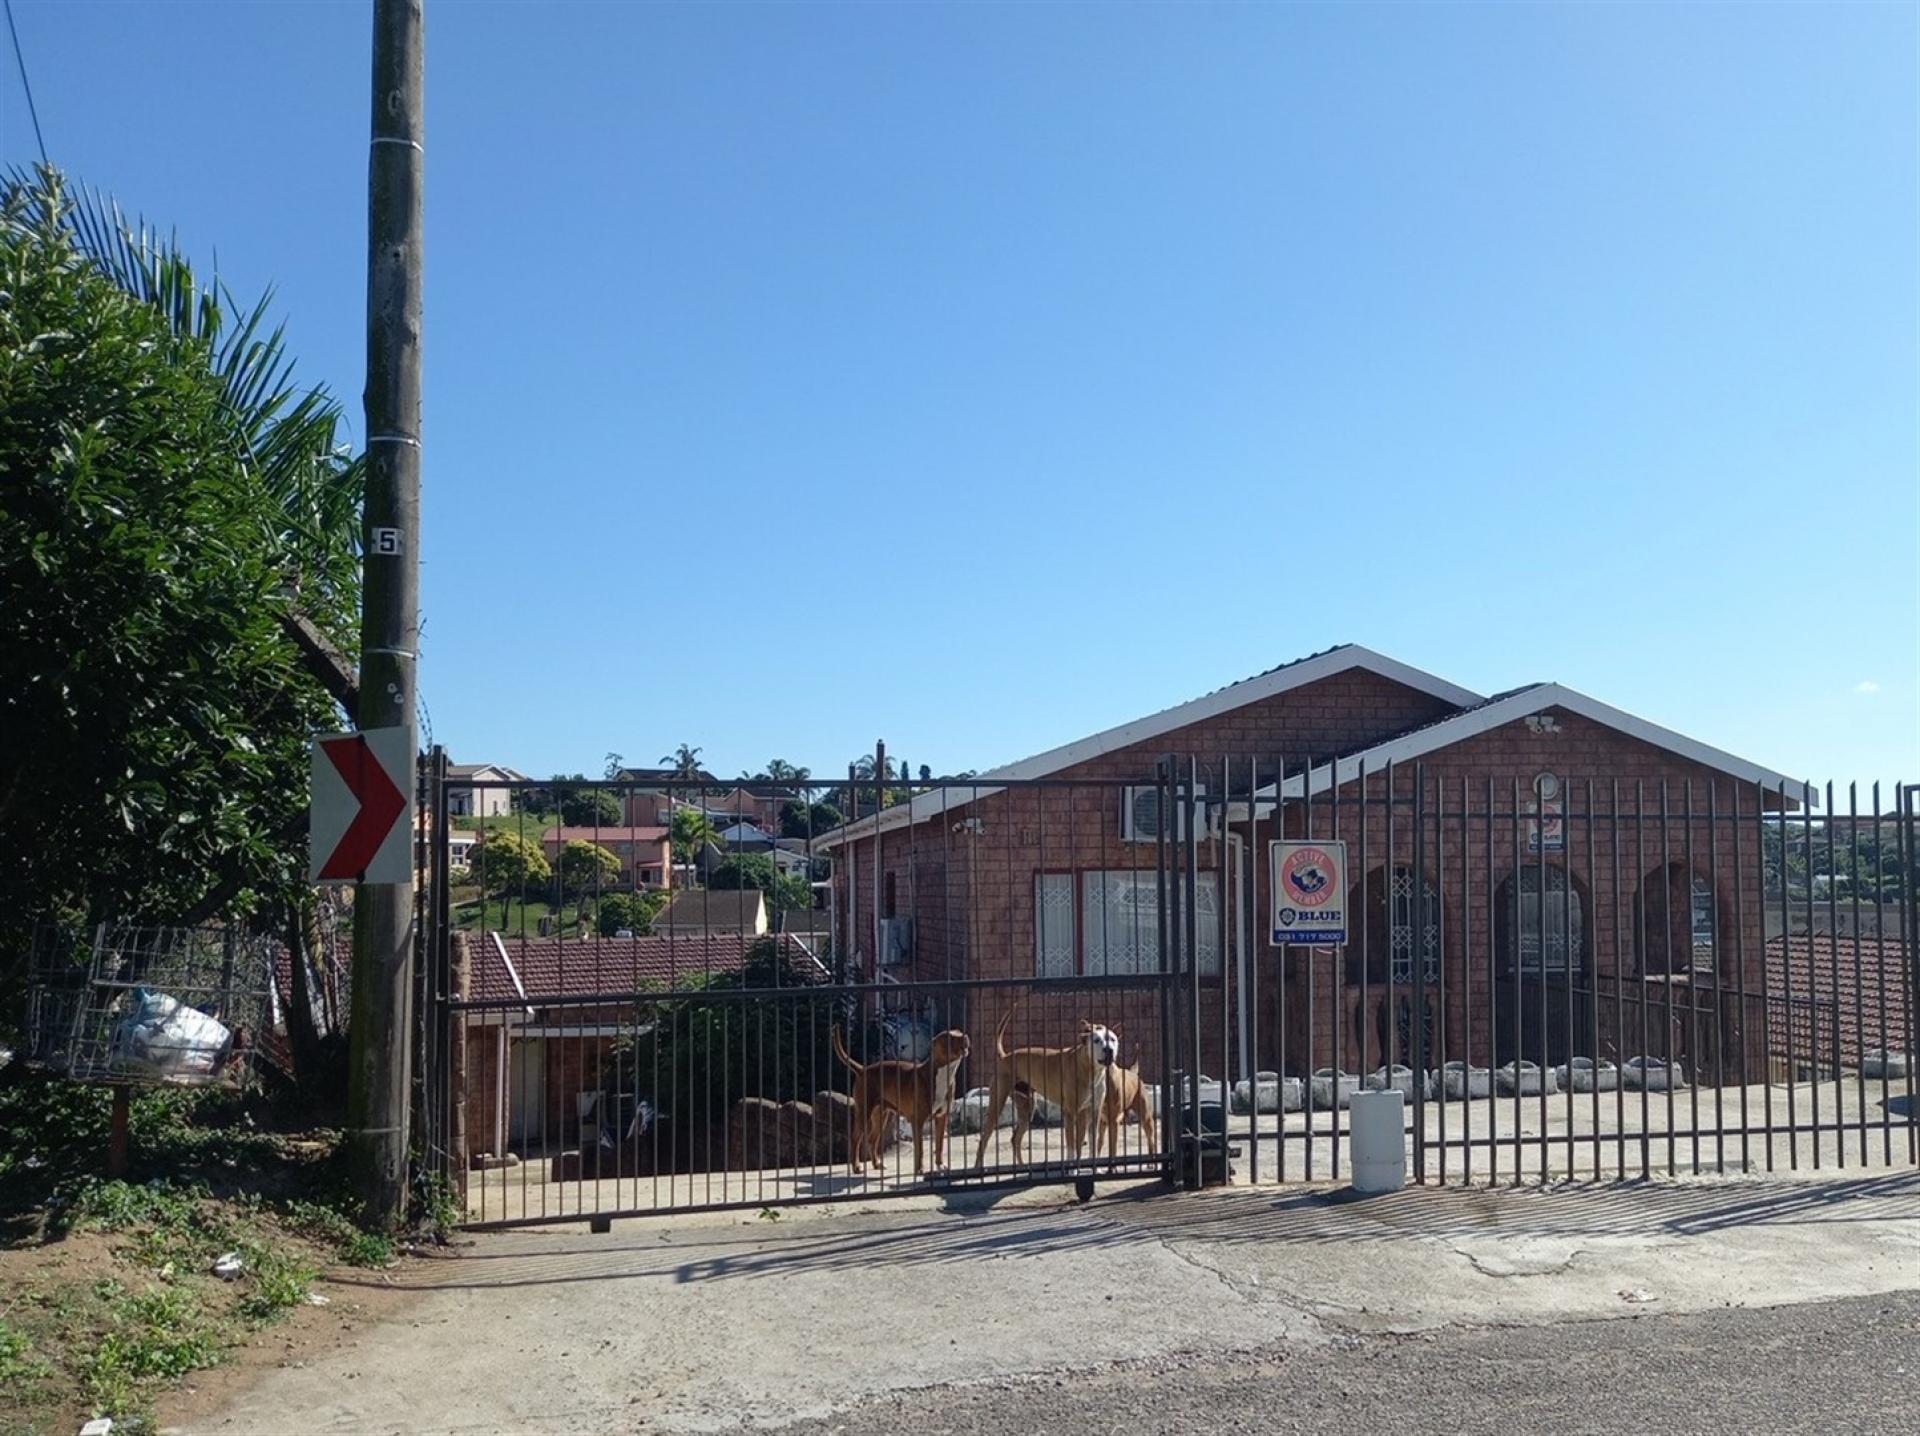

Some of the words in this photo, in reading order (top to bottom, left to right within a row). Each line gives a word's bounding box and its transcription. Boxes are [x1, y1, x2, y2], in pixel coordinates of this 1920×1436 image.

[380, 531, 395, 552] 5
[1290, 850, 1326, 865] ACTIVE
[1291, 890, 1328, 905] MEMBER
[1298, 911, 1341, 921] BLUE
[1299, 932, 1317, 941] 717
